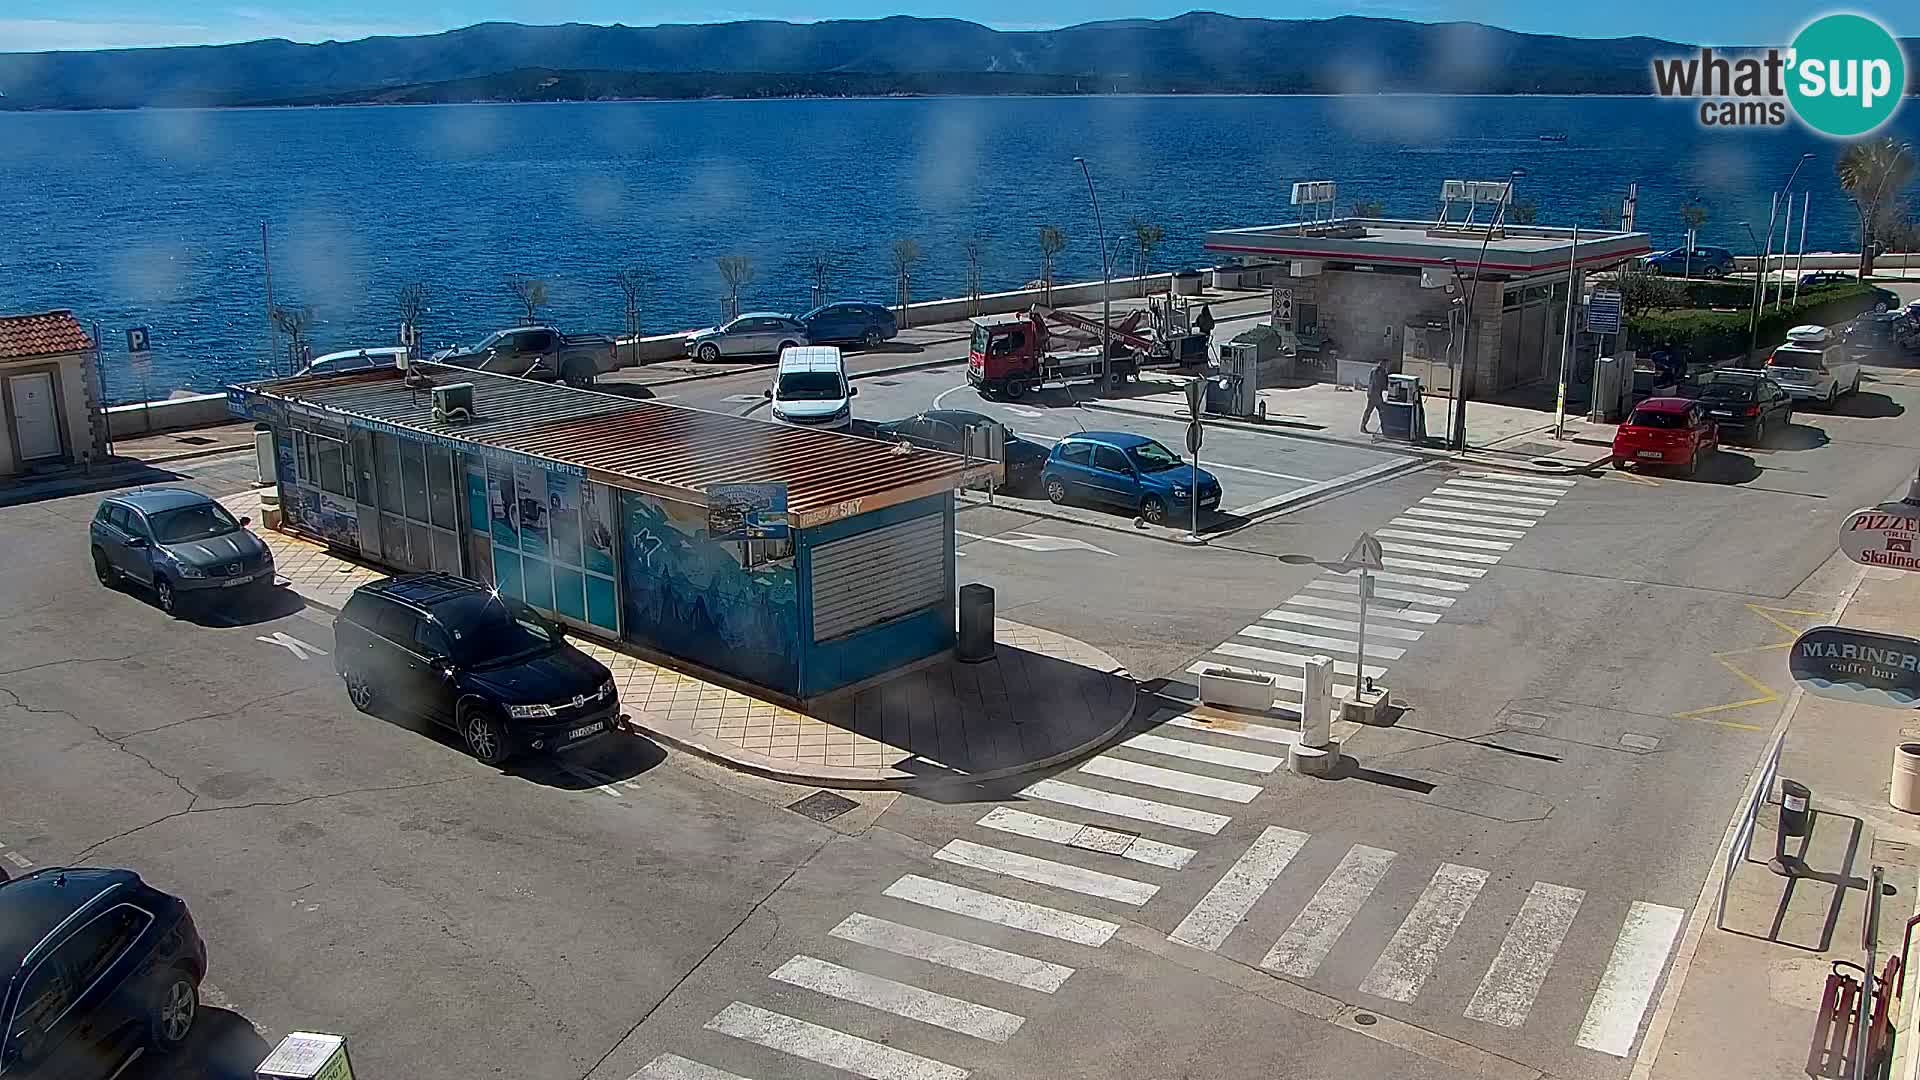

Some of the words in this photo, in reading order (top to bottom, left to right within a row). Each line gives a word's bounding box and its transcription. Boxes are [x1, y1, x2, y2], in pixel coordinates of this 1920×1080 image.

[131, 330, 144, 349] P
[529, 457, 555, 471] TICKET
[556, 462, 583, 477] OFFICE
[1849, 515, 1920, 534] PIZZE
[1883, 530, 1918, 541] GRILL
[1802, 642, 1920, 673] MARINER
[1830, 662, 1866, 675] caffe
[1871, 665, 1898, 680] bar
